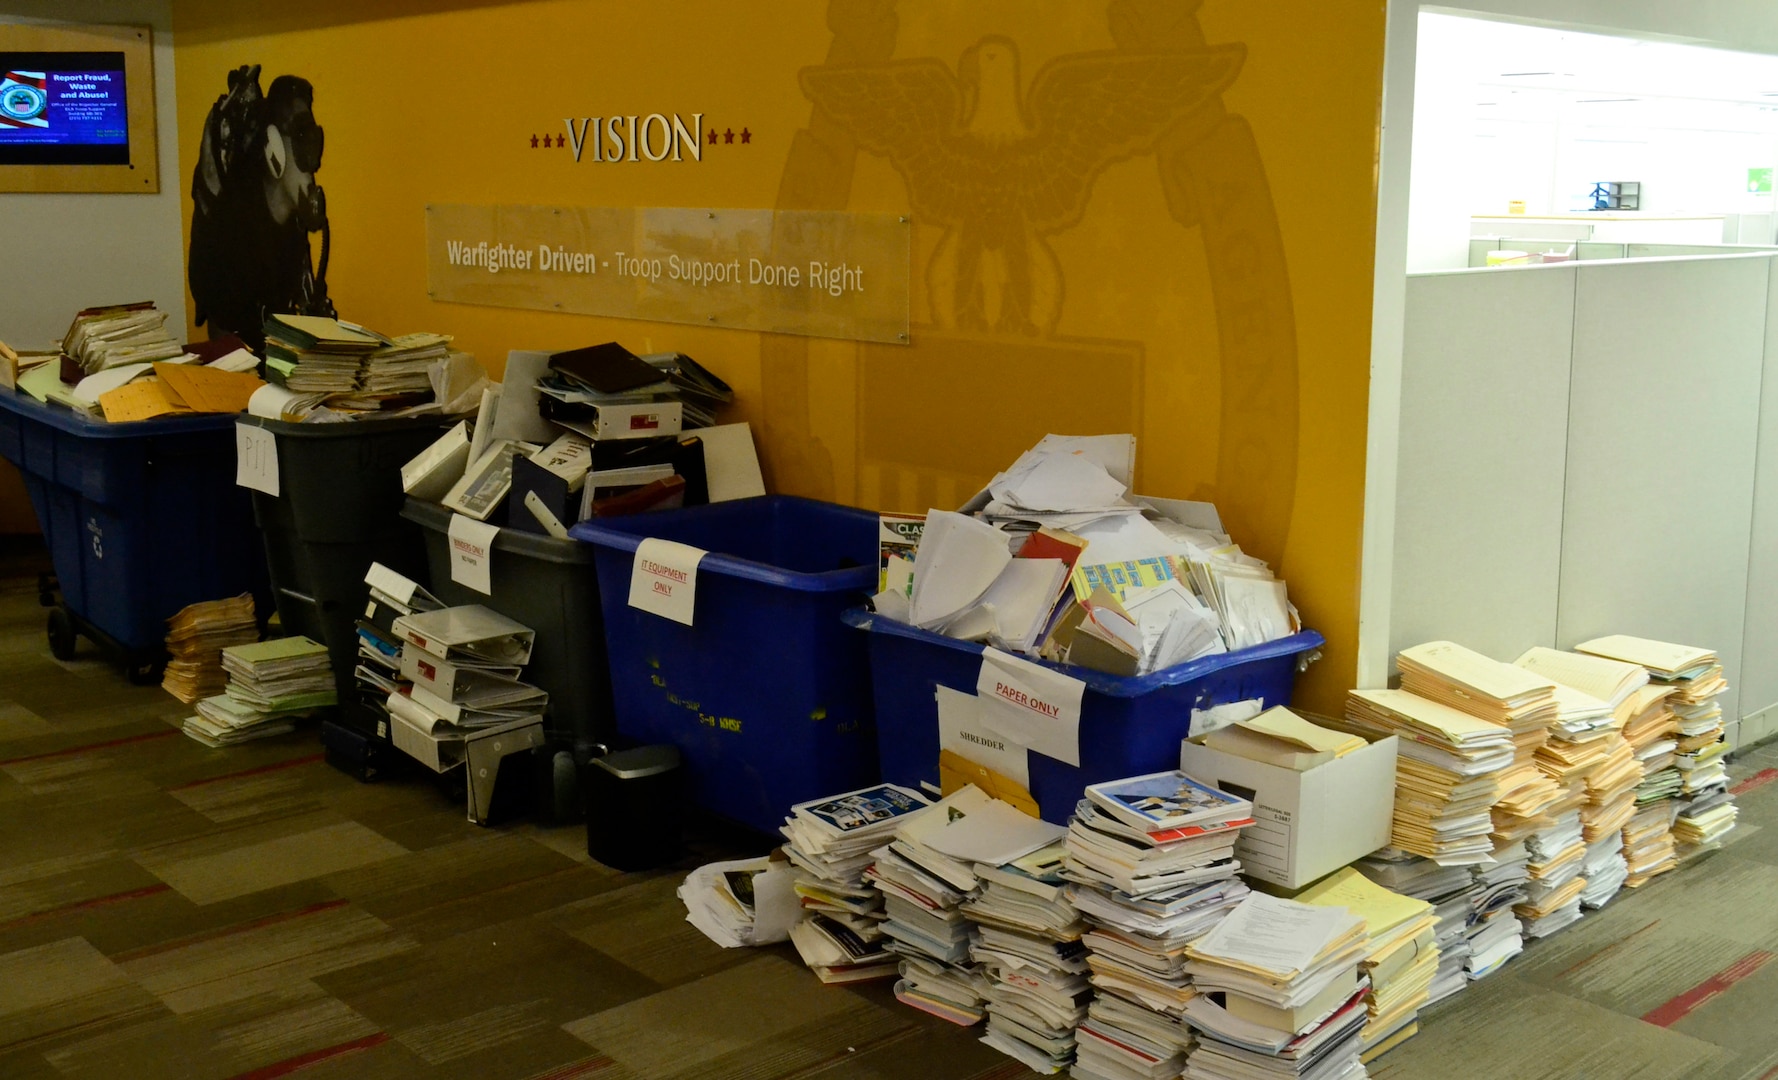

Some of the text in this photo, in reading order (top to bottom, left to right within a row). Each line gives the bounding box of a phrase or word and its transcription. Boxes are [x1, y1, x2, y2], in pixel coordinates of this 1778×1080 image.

[53, 74, 111, 82] Report Fraud,
[60, 91, 109, 99] and Abuse!
[563, 113, 704, 163] VISION
[447, 240, 533, 274] Warfighter
[539, 244, 596, 274] Driven
[615, 251, 662, 284] Troop
[668, 254, 741, 287] Support
[749, 258, 800, 288] Done
[809, 261, 864, 297] Right
[641, 559, 688, 582] IT EQUIPMENT
[654, 581, 673, 595] ONLY
[996, 681, 1060, 717] PAPER ONLY
[960, 730, 1005, 752] SHREDDER
